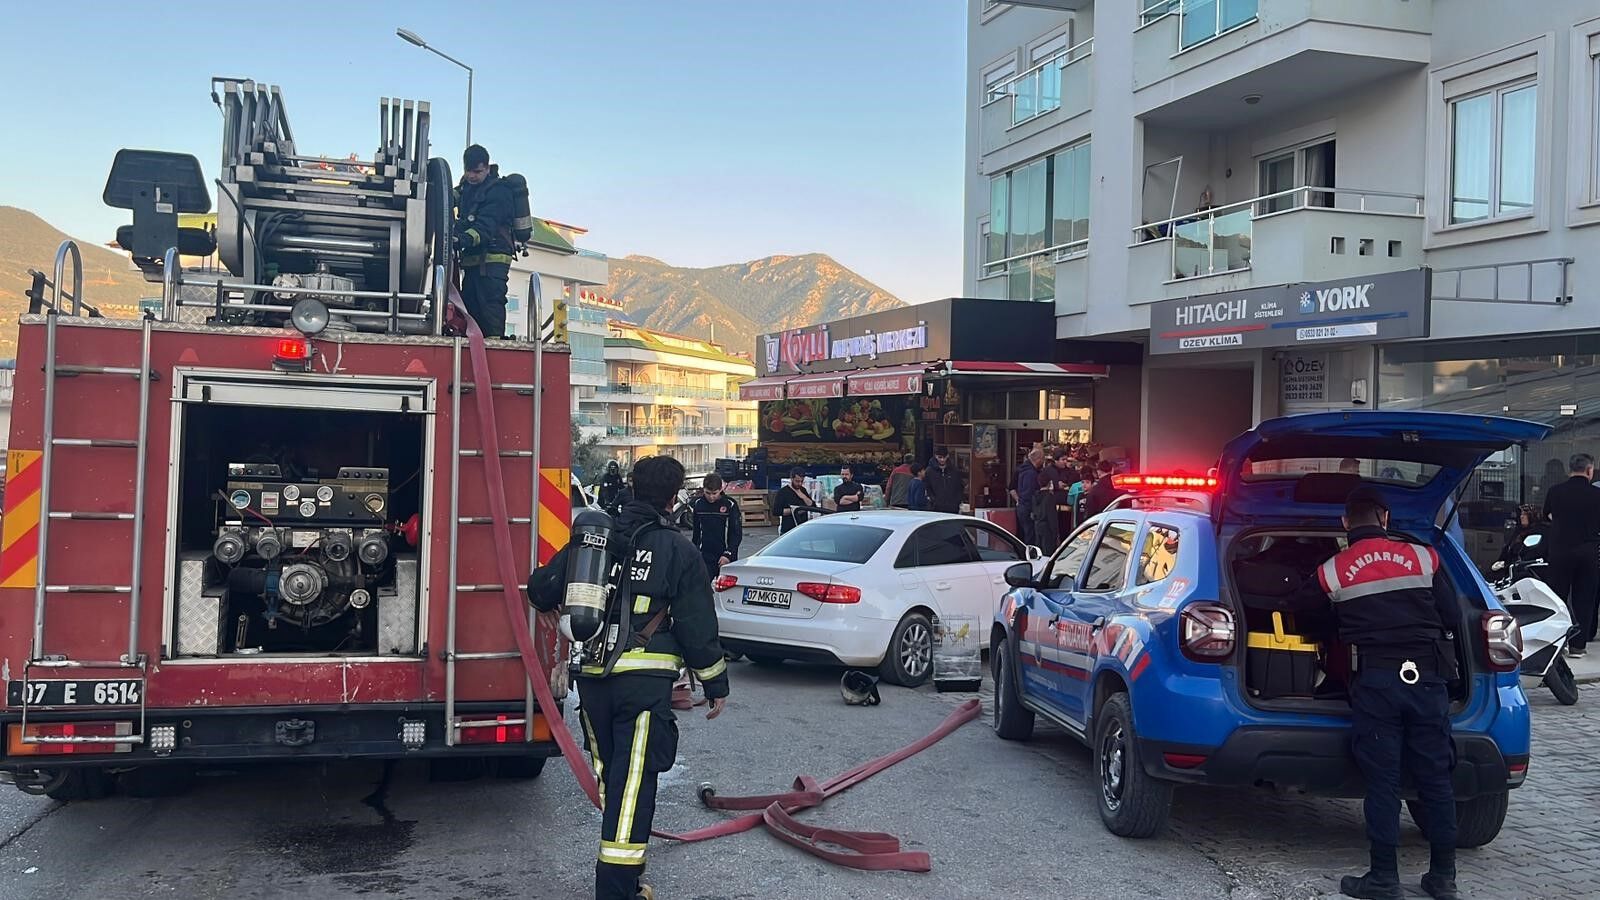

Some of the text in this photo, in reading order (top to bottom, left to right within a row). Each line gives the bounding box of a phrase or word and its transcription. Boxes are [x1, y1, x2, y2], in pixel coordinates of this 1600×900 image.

[1261, 302, 1277, 310] KLİMA
[1316, 285, 1370, 312] YORK
[1175, 300, 1247, 325] HITACHI
[1254, 308, 1284, 319] SİSTEMLERİ
[1209, 335, 1238, 346] KLİMA
[1345, 551, 1413, 582] JANDARMA
[747, 589, 789, 604] 07 MKG 04
[23, 682, 139, 704] 07 E 6514
